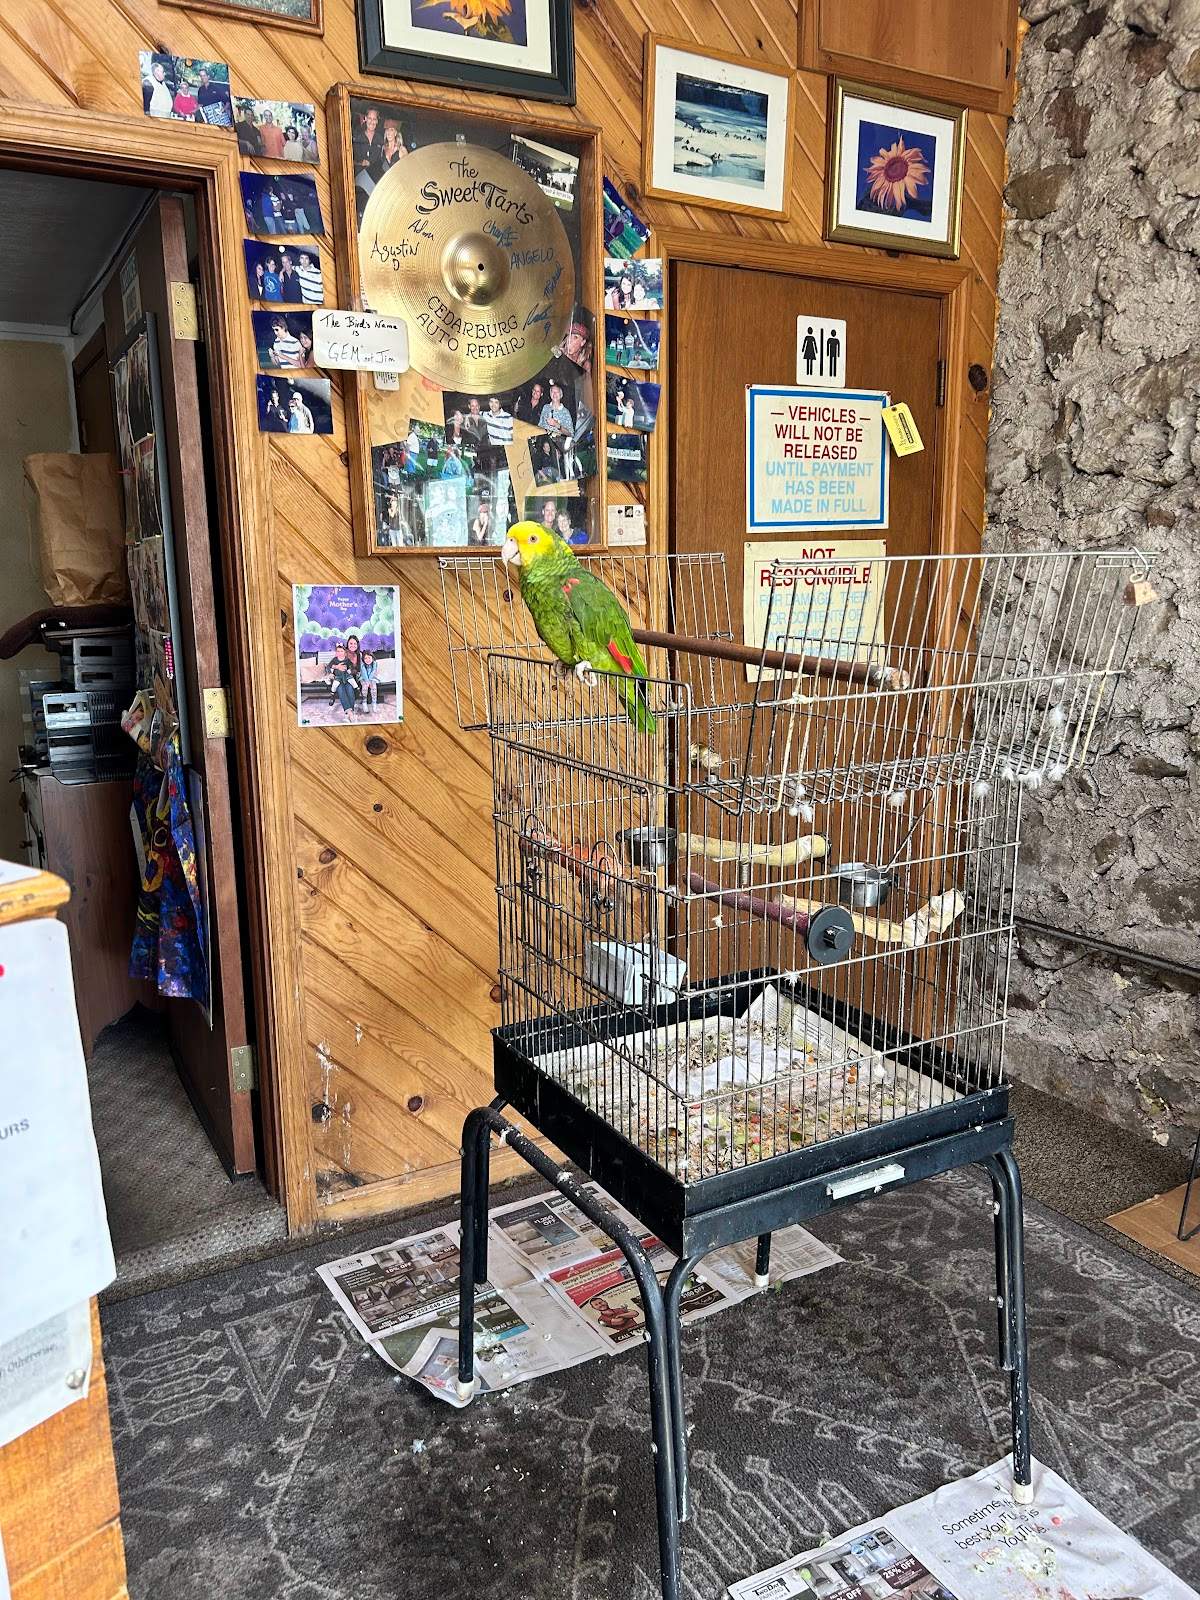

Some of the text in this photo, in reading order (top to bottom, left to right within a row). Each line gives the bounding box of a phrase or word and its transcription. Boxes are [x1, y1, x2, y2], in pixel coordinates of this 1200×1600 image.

[449, 156, 479, 179] The
[416, 181, 534, 225] Sweet Tarts
[510, 247, 554, 269] ANGELO
[320, 312, 341, 328] The
[374, 319, 399, 330] Name
[427, 296, 519, 339] CEDARBURG
[416, 312, 526, 360] AUTO REPAIR
[375, 348, 397, 363] Jim
[788, 405, 857, 424] VEHICLES
[775, 424, 863, 442] WILL NOT BE
[784, 443, 857, 460] RELEASED
[766, 461, 873, 478] UNTIL PAYMENT
[785, 480, 855, 495] HAS BEEN
[771, 498, 866, 514] MADE IN FULL
[802, 548, 835, 560] NOT
[760, 567, 871, 586] RESPONSIBLE
[955, 1508, 1040, 1549] best YouTue is
[882, 1564, 902, 1579] 25%
[901, 1558, 916, 1570] OFF
[846, 1587, 862, 1600] OFF
